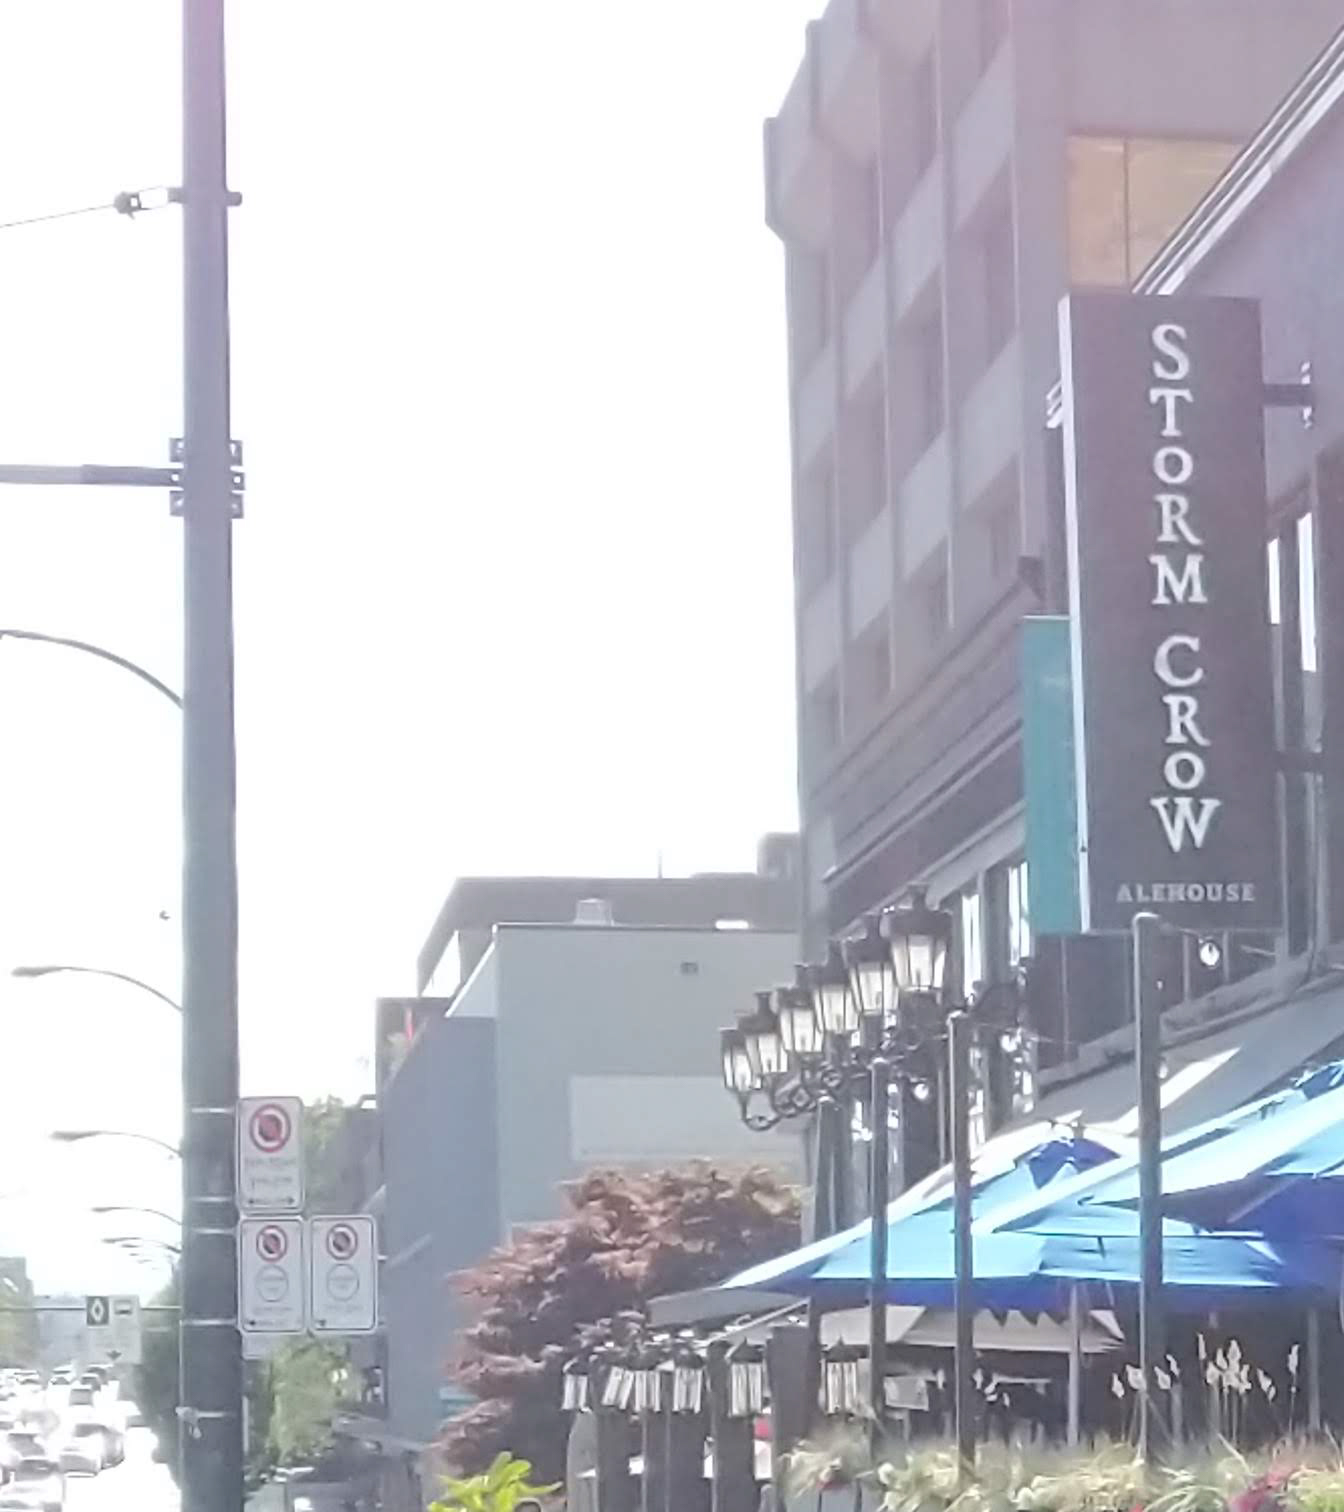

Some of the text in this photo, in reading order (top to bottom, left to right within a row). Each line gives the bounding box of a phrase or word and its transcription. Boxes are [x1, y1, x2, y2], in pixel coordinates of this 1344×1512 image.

[1148, 323, 1222, 853] STORM CROW
[1115, 882, 1256, 903] ALEHOUSE
